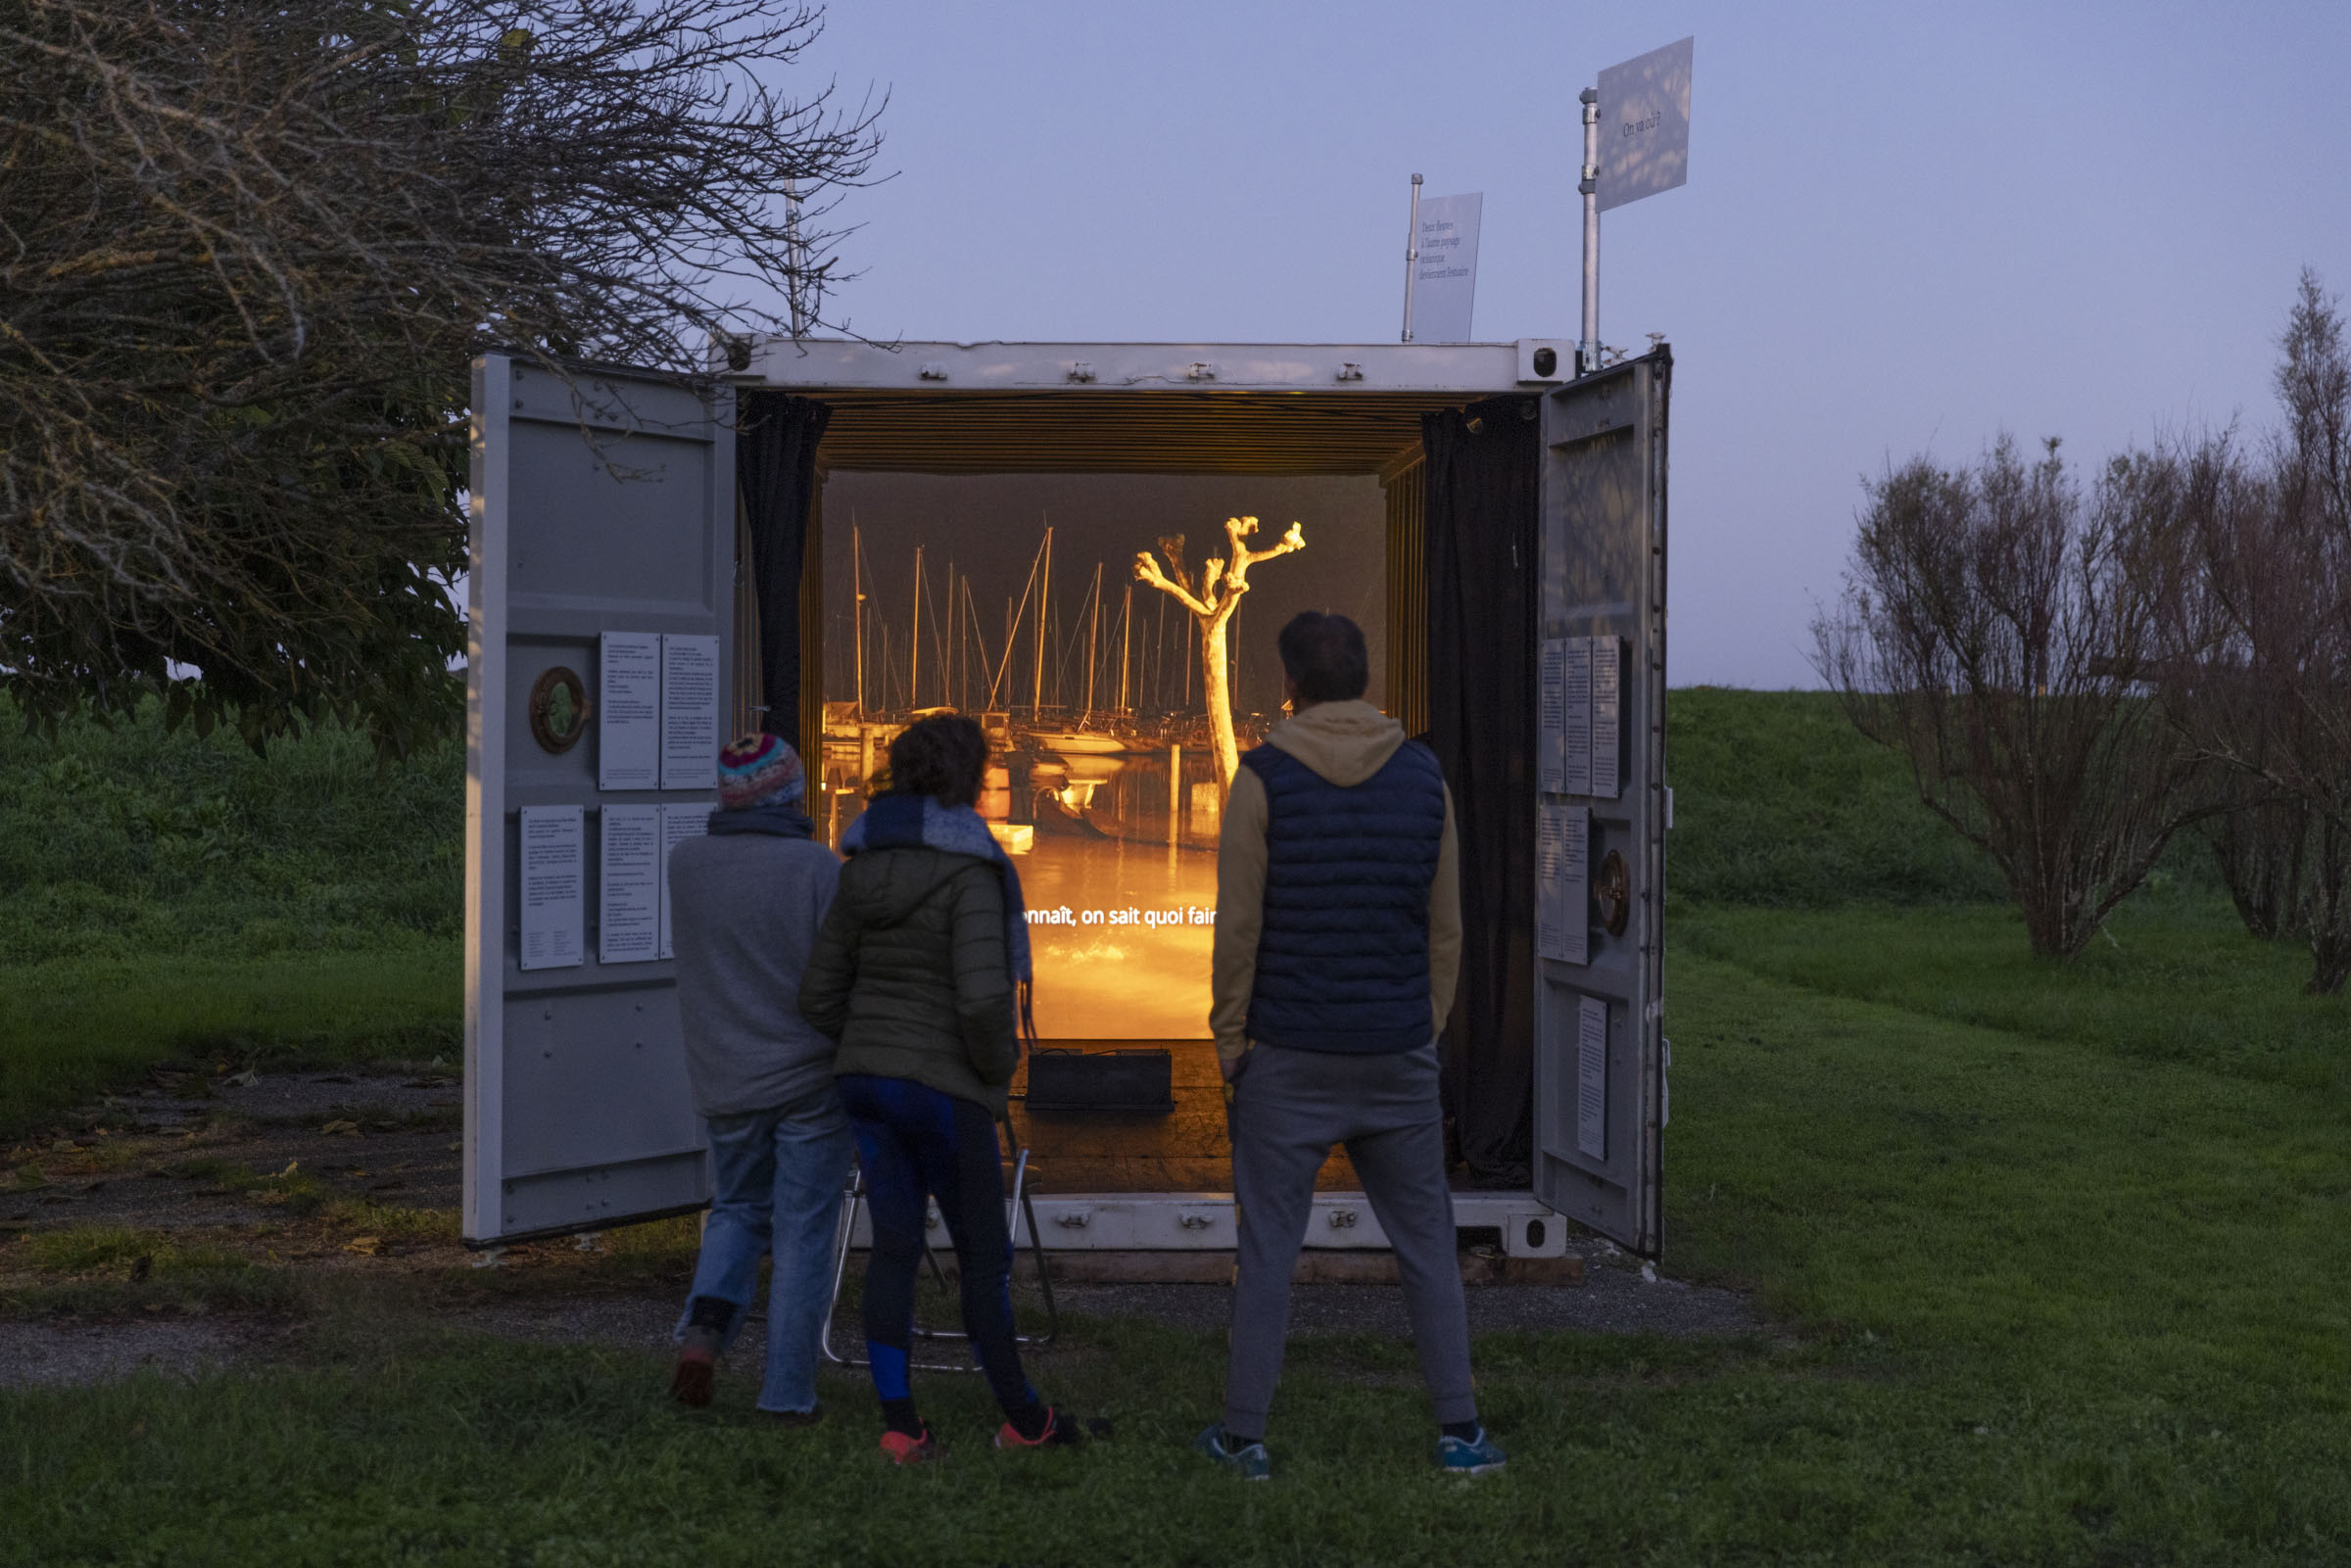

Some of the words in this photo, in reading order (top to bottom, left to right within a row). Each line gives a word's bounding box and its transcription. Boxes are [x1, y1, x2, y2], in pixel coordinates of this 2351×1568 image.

[1623, 122, 1634, 137] On
[1081, 909, 1104, 925] on
[1109, 906, 1140, 925] sait
[1144, 906, 1183, 928] quoi
